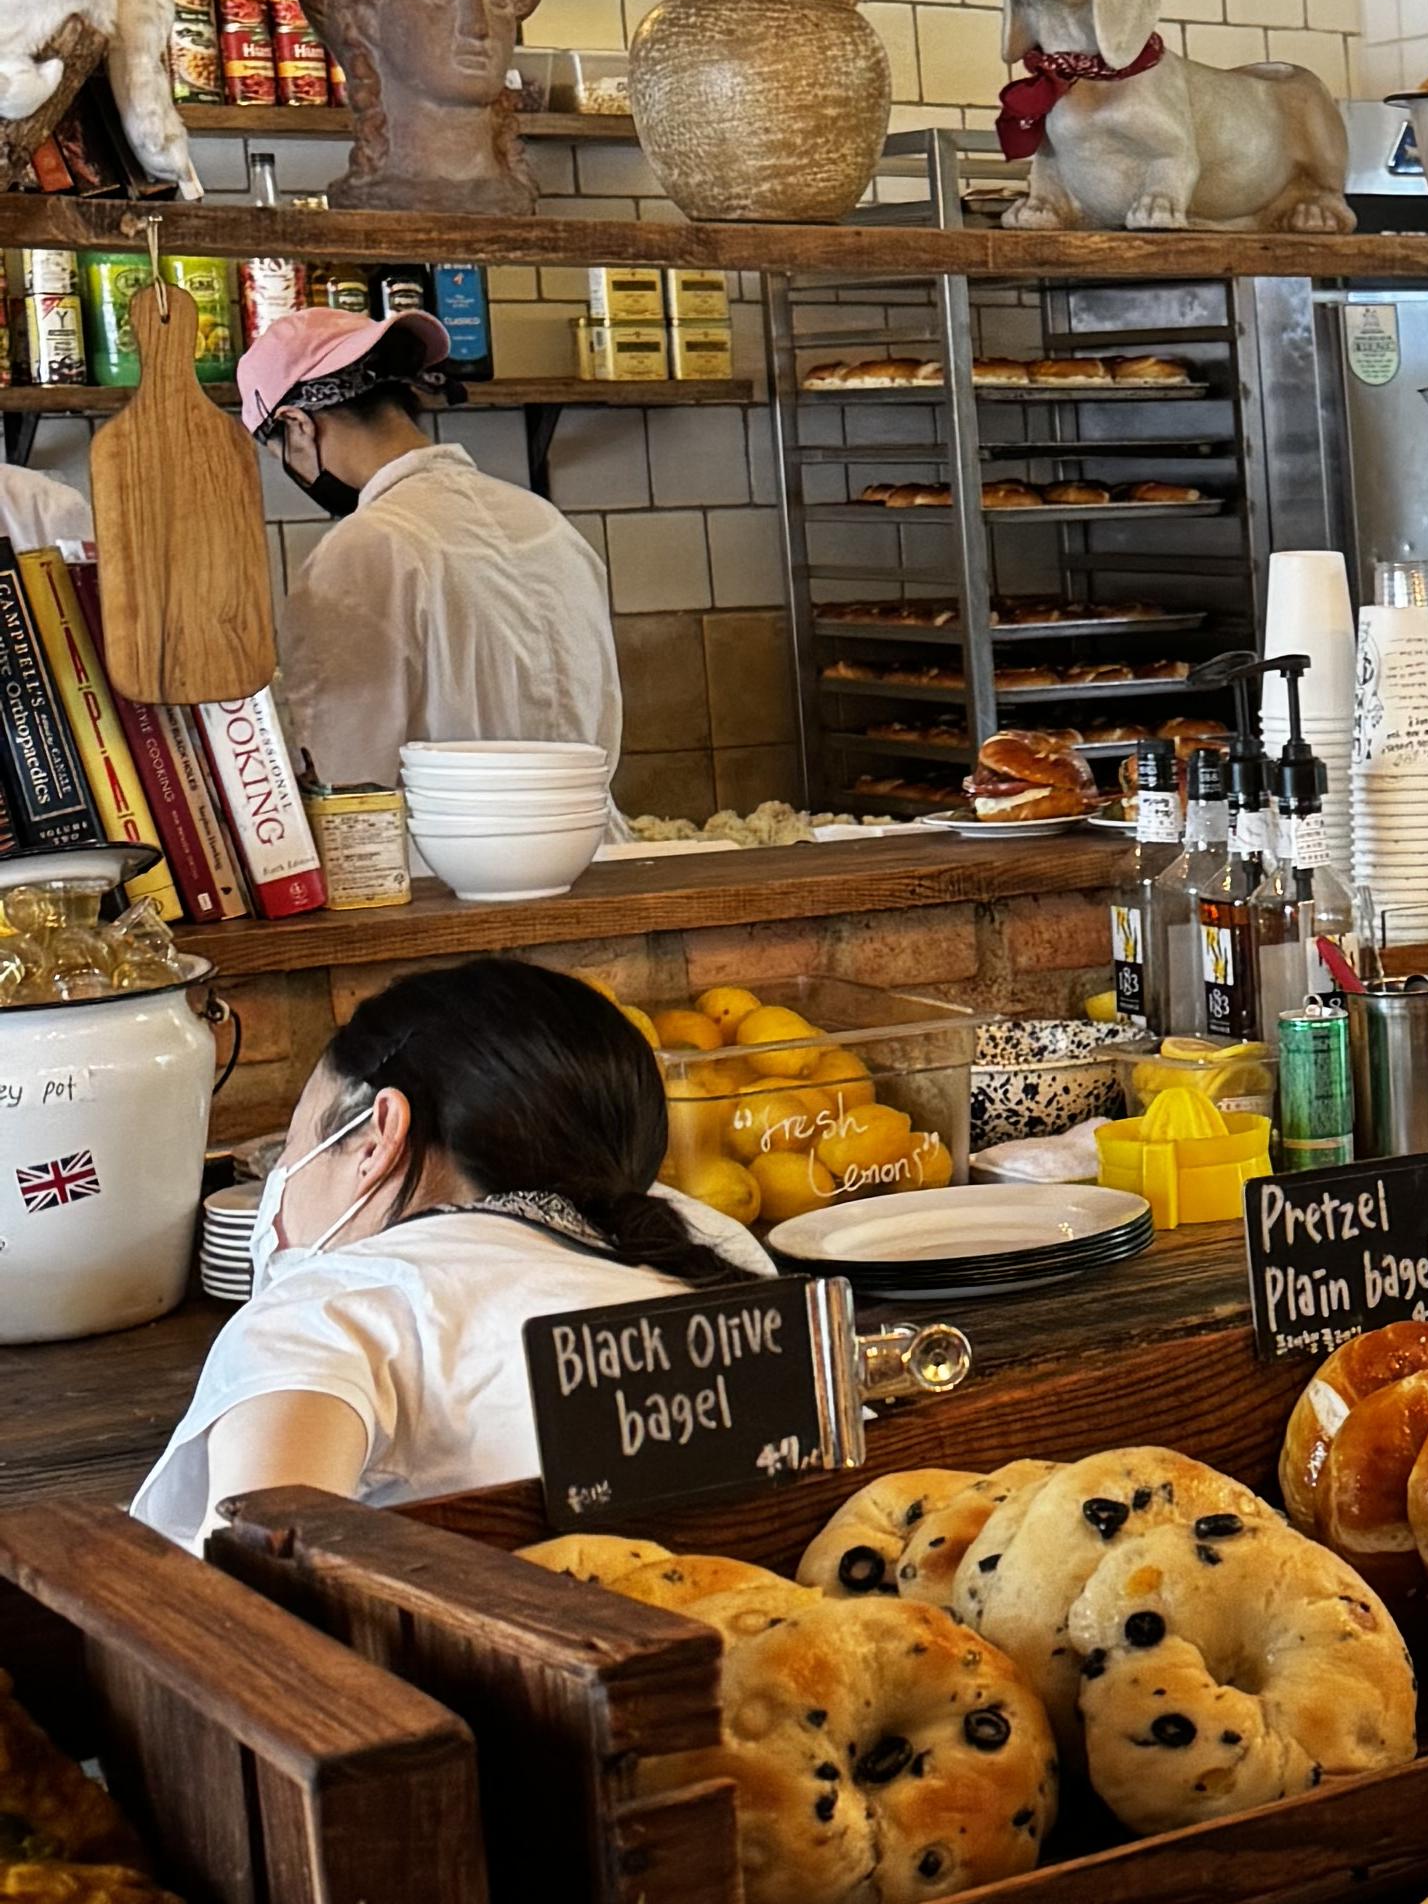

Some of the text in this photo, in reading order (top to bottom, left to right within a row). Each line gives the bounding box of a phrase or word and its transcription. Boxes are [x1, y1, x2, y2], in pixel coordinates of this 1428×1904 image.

[6, 679, 50, 804] Orthopaedics
[43, 1075, 77, 1104] pot
[1261, 1179, 1389, 1253] Pretzel
[1265, 1266, 1351, 1333] Plain
[552, 1307, 783, 1396] Black Olive
[615, 1374, 732, 1456] bagel
